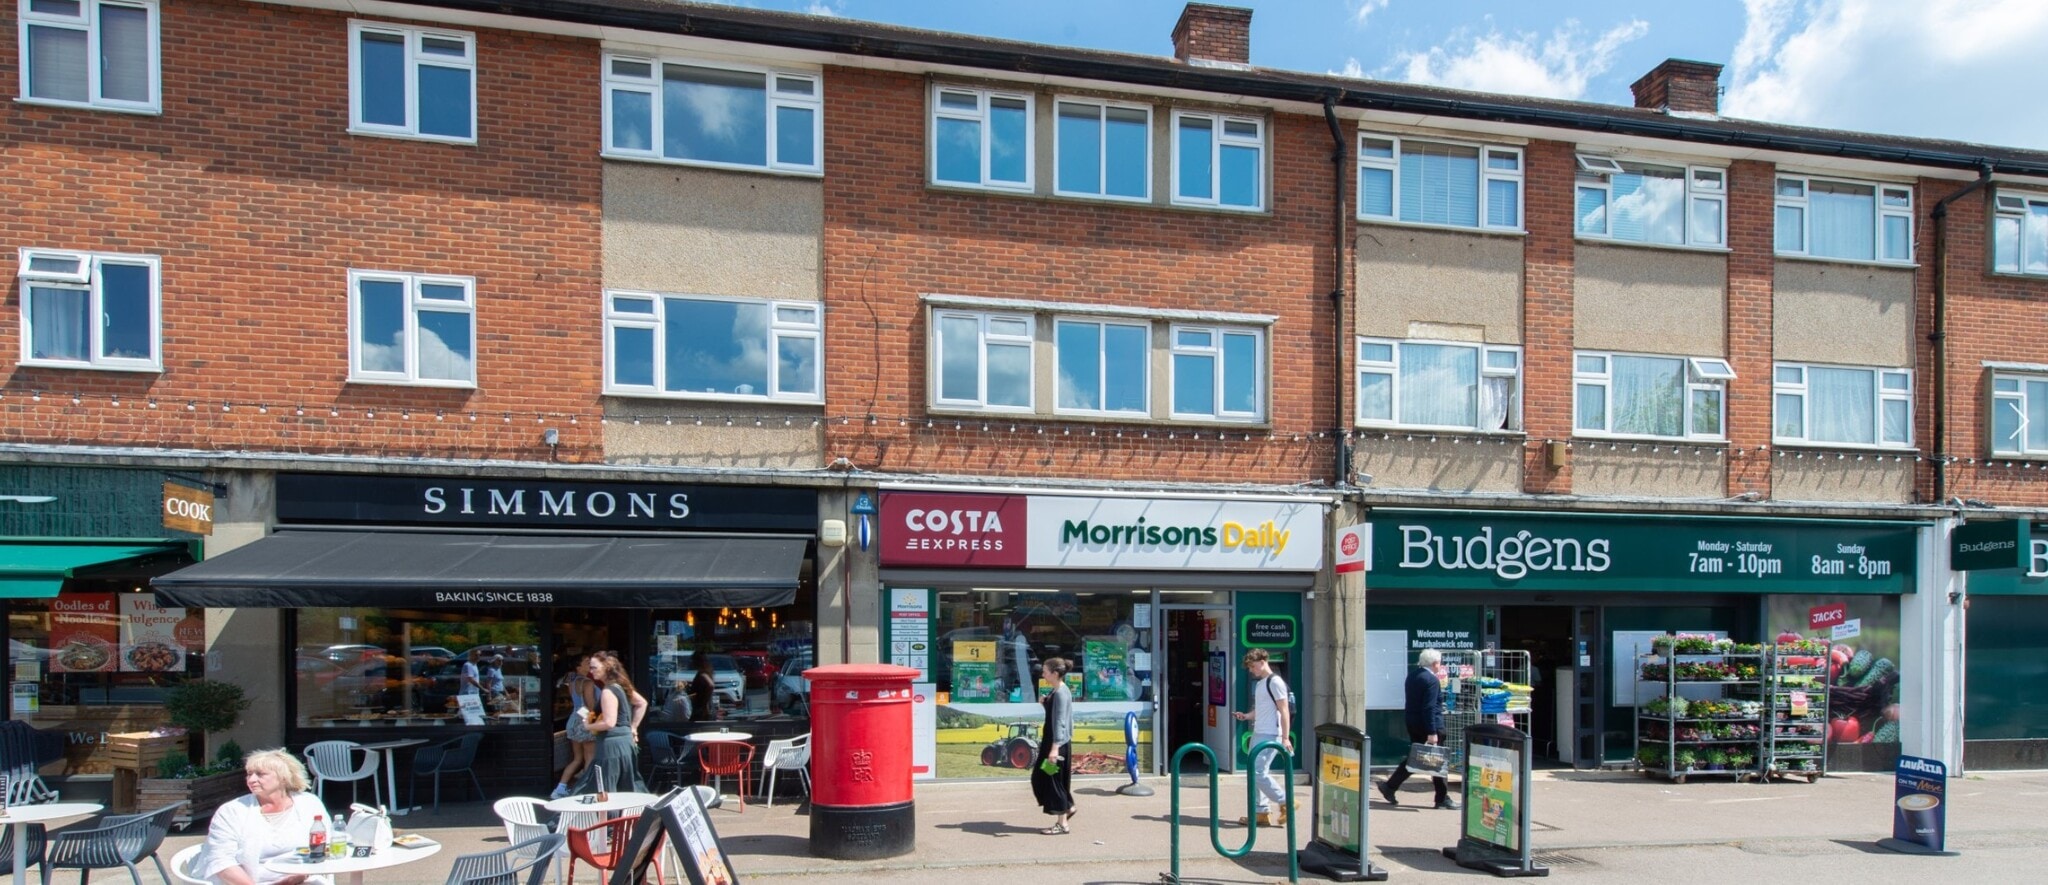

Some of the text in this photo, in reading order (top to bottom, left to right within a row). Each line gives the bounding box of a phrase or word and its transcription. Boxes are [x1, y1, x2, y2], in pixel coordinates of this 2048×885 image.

[166, 497, 212, 522] COOK
[423, 487, 690, 519] SIMMONS
[905, 508, 1003, 535] COSTA
[1063, 516, 1290, 556] Morrisons Daily
[921, 538, 1003, 551] EXPRESS
[1698, 540, 1730, 554] Monday
[1736, 541, 1773, 555] Saturday
[1837, 543, 1866, 556] Sunday
[1959, 540, 2015, 553] Budgens
[1398, 525, 1611, 580] Budgens
[1688, 552, 1723, 573] 7am
[1737, 553, 1782, 578] 10pm
[1811, 554, 1845, 575] 8am
[1858, 555, 1891, 579] 8pm
[435, 591, 553, 603] BAKING SINCE 1838
[54, 600, 111, 611] Oodles of
[59, 614, 107, 624] Noodles
[1812, 609, 1843, 624] JACK'S
[1251, 630, 1290, 638] withdrawals
[1416, 629, 1469, 640] Welcome to your
[1412, 640, 1474, 648] Marshalswick store
[69, 731, 95, 745] We
[1899, 759, 1943, 775] LAVAZZA
[1917, 779, 1943, 792] Move
